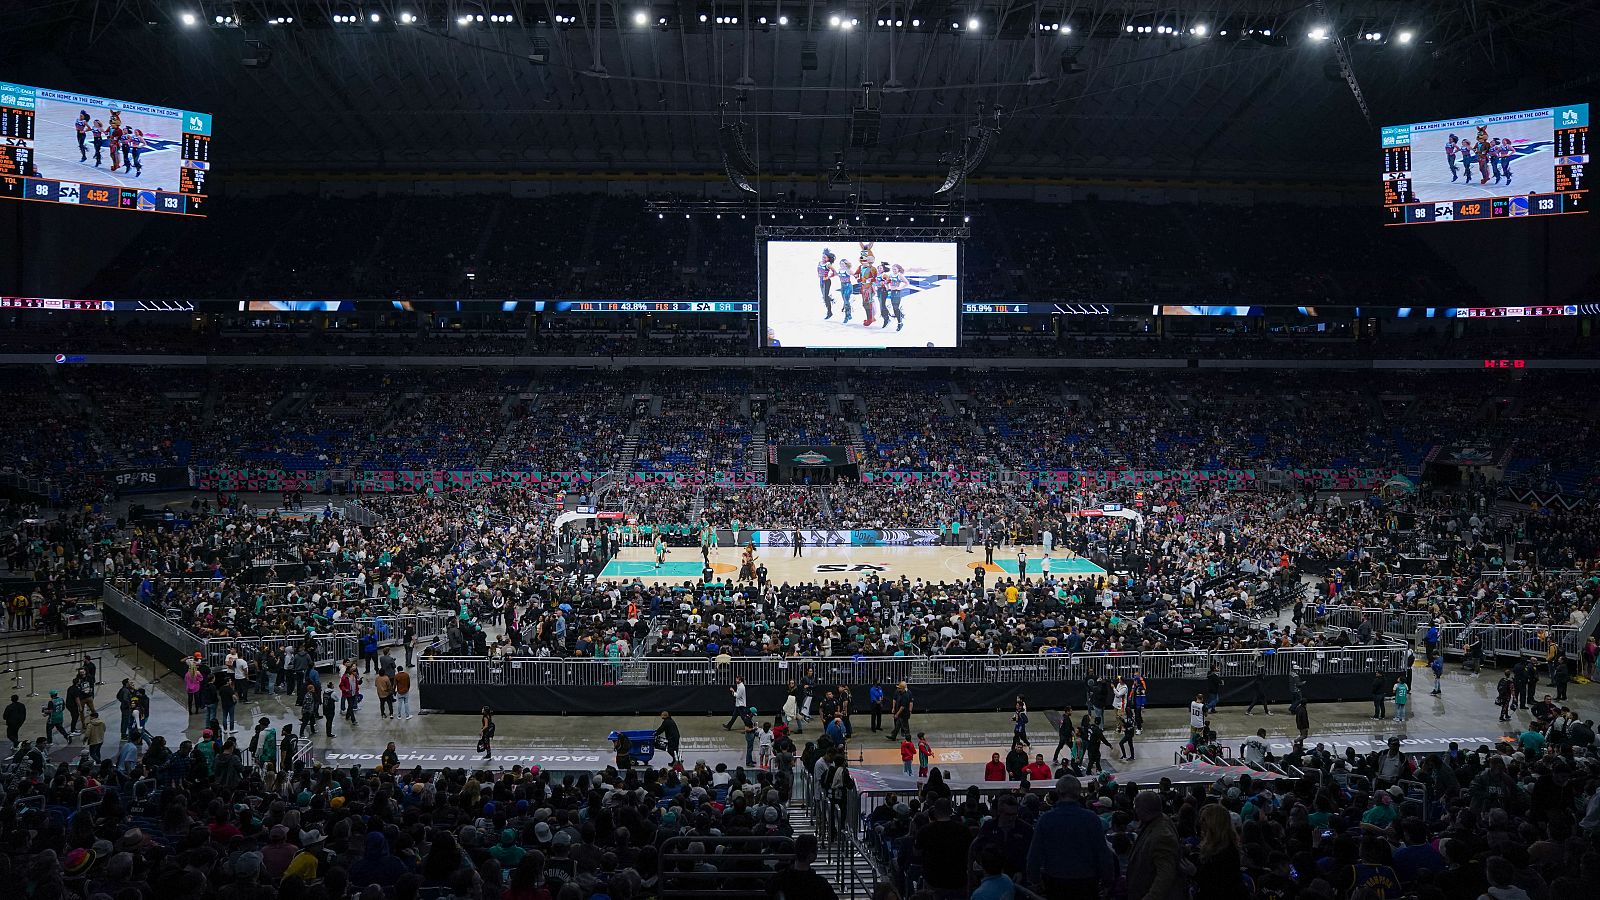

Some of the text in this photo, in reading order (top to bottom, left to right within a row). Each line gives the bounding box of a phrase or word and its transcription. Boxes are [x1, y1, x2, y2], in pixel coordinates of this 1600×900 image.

[6, 137, 27, 148] SA
[1389, 172, 1406, 180] SA
[35, 184, 49, 196] 98
[59, 186, 79, 198] SA
[87, 189, 109, 202] 4:52
[122, 198, 131, 206] 24
[164, 197, 178, 208] 133
[1538, 199, 1554, 210] 133
[1414, 208, 1426, 218] 98
[1435, 206, 1453, 217] SA
[1459, 203, 1481, 216] 4:52
[620, 302, 648, 311] 43.8%
[697, 302, 711, 311] SA
[742, 303, 753, 311] 98
[966, 304, 993, 312] 55.9%
[995, 305, 1008, 313] TOL
[816, 563, 888, 573] SA
[1192, 708, 1200, 717] 10
[1434, 736, 1493, 745] BACK
[469, 754, 537, 762] HOME
[538, 754, 601, 762] BACK
